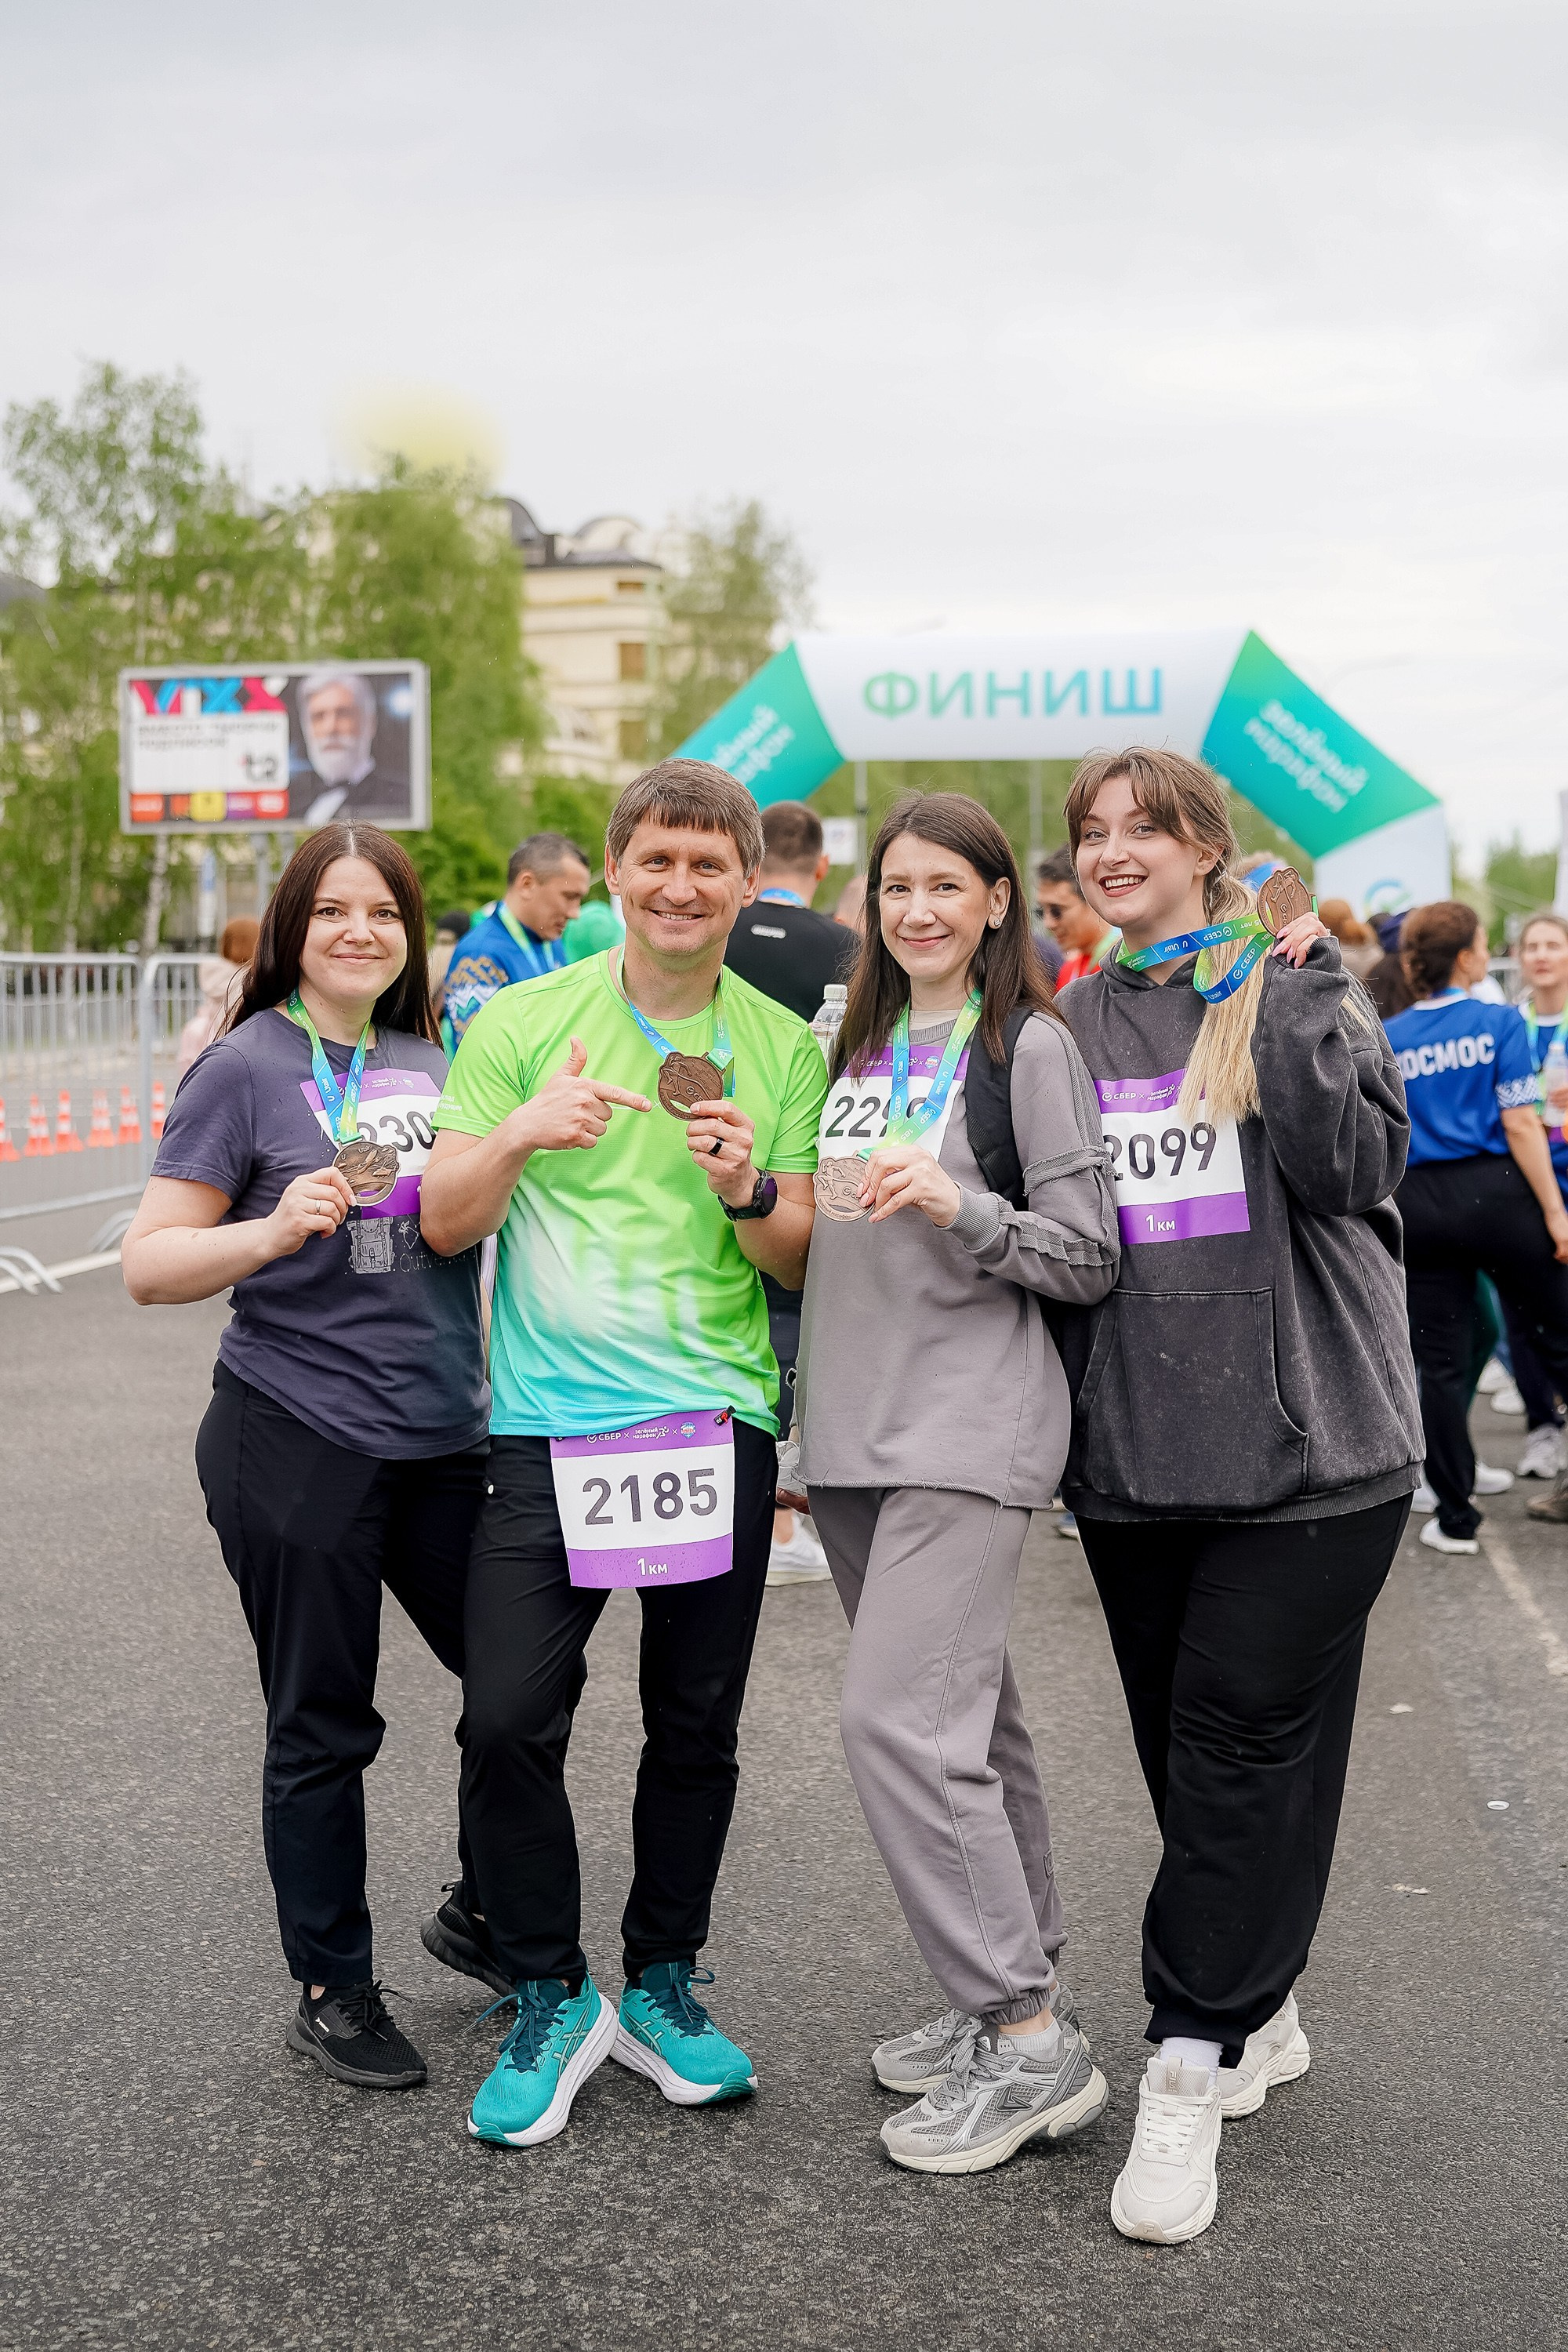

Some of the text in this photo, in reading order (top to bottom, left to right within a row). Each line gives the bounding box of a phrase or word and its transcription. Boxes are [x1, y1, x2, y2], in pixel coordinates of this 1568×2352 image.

[863, 668, 1161, 720] ФИНИШ
[1203, 930, 1223, 942] СБЕР
[1163, 943, 1180, 953] Utair
[1240, 948, 1256, 969] СБЕР
[1208, 990, 1222, 1000] Utair
[321, 1077, 332, 1094] Utair
[1102, 1122, 1217, 1181] 2099
[598, 1432, 622, 1441] СБЕР
[635, 1426, 659, 1435] зелёный
[583, 1468, 717, 1526] 2185
